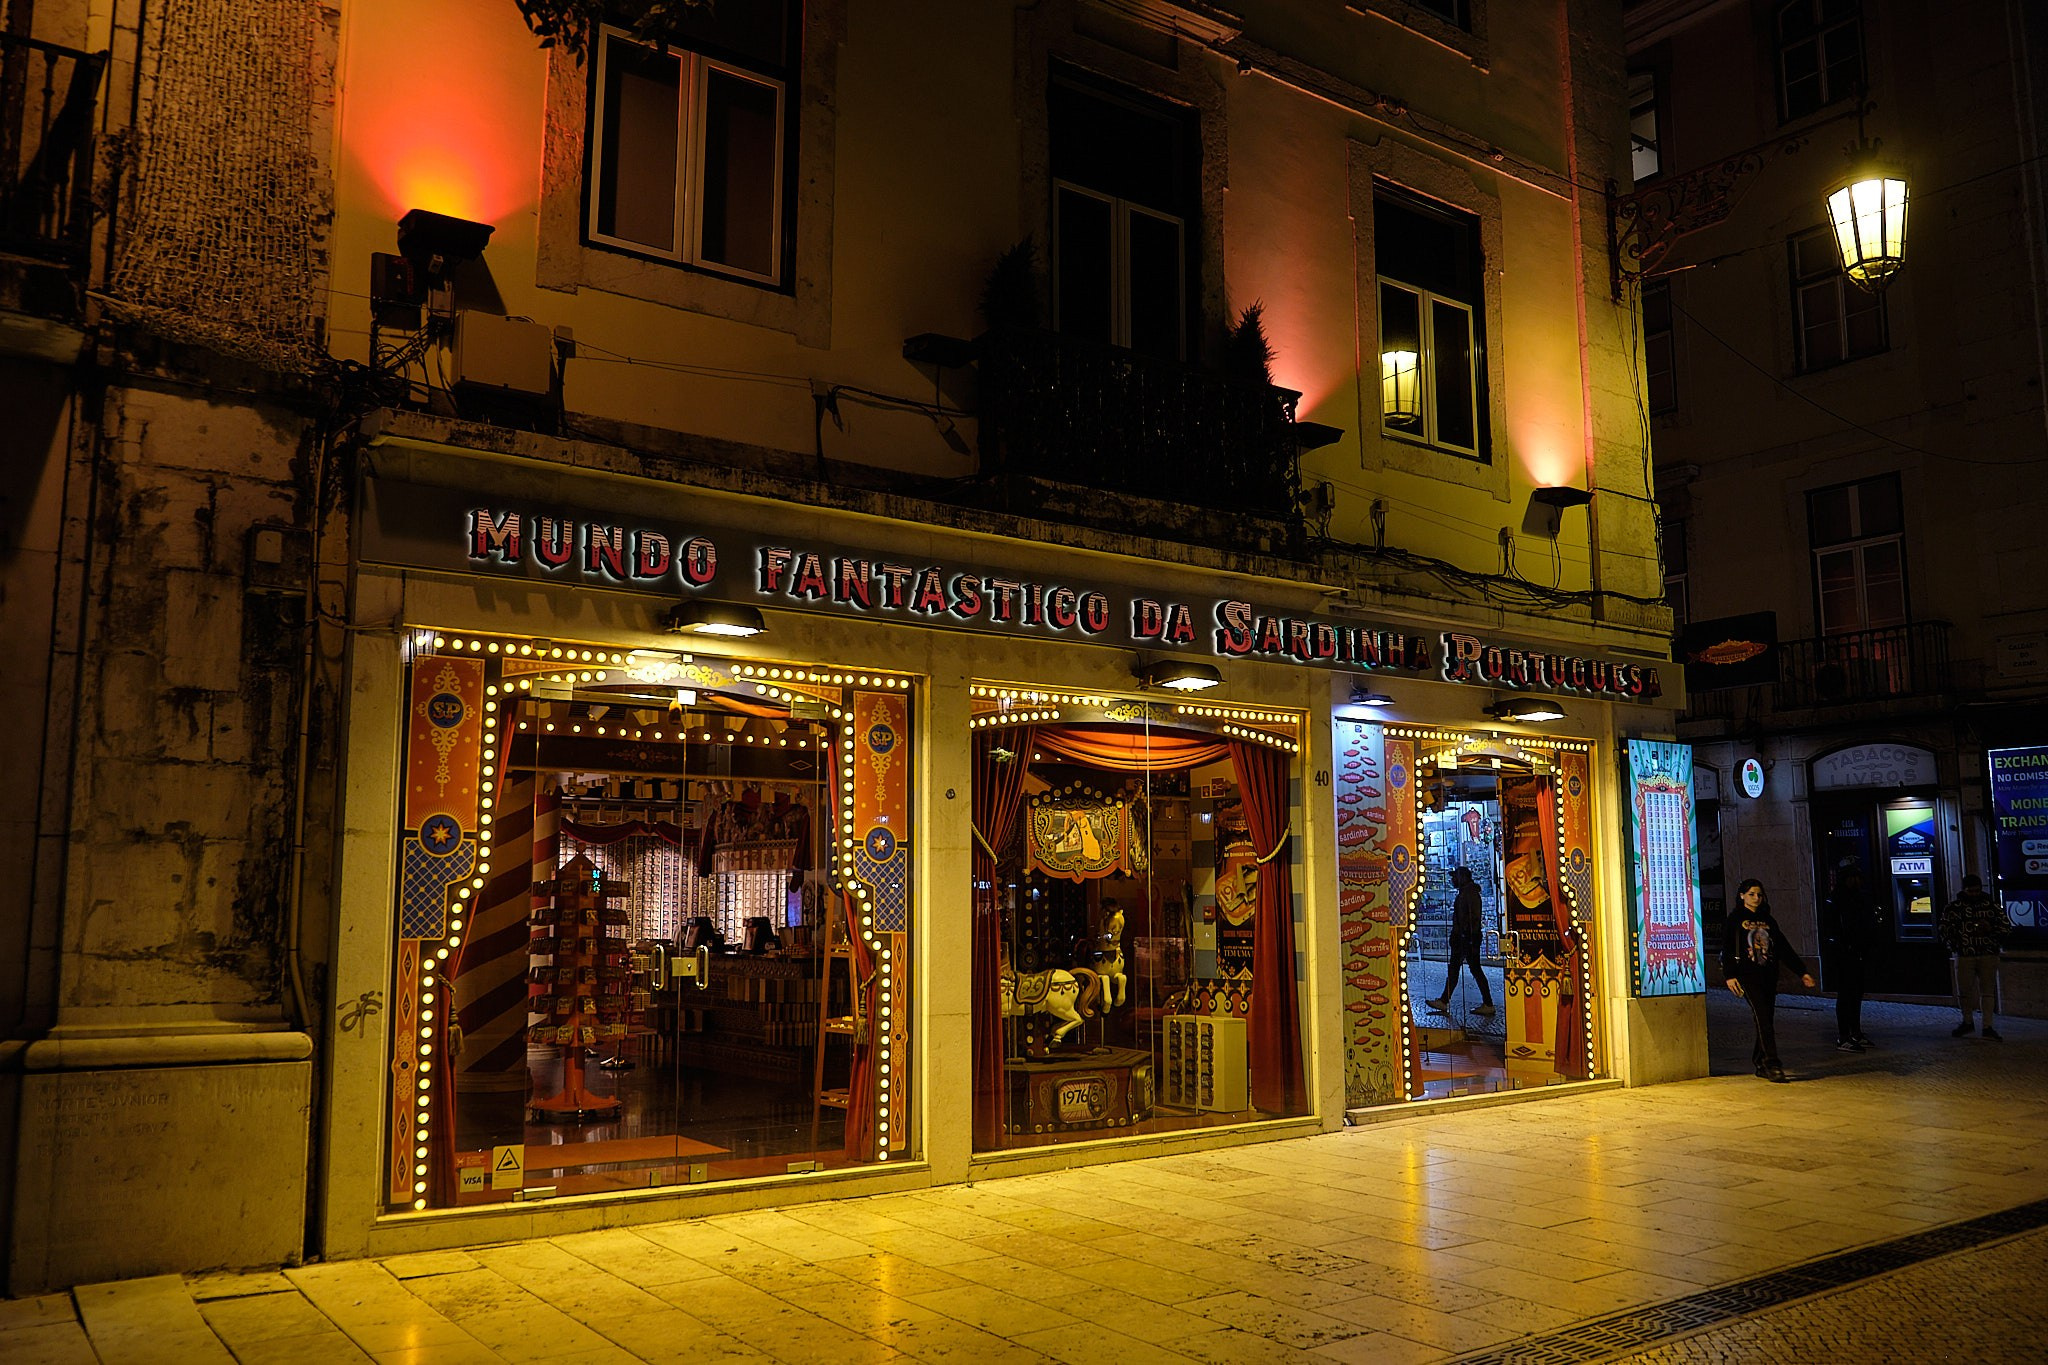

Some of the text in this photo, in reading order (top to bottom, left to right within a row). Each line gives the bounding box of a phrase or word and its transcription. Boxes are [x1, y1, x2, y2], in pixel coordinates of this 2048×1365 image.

[468, 508, 1663, 697] MUNDO FANTÁSTICO DA SARDINHA PORTUGUESA
[1827, 747, 1918, 770] TABACOS
[1315, 770, 1329, 786] 40
[1831, 768, 1917, 787] LIVROS
[1997, 774, 2011, 782] NO
[2000, 815, 2048, 828] TRANS
[1340, 829, 1368, 842] sardinha
[1899, 863, 1925, 871] ATM
[1650, 933, 1690, 941] SARDINHA
[1647, 940, 1694, 949] PORTUGUESA
[1063, 1088, 1088, 1105] 1976
[464, 1177, 482, 1185] VISA
